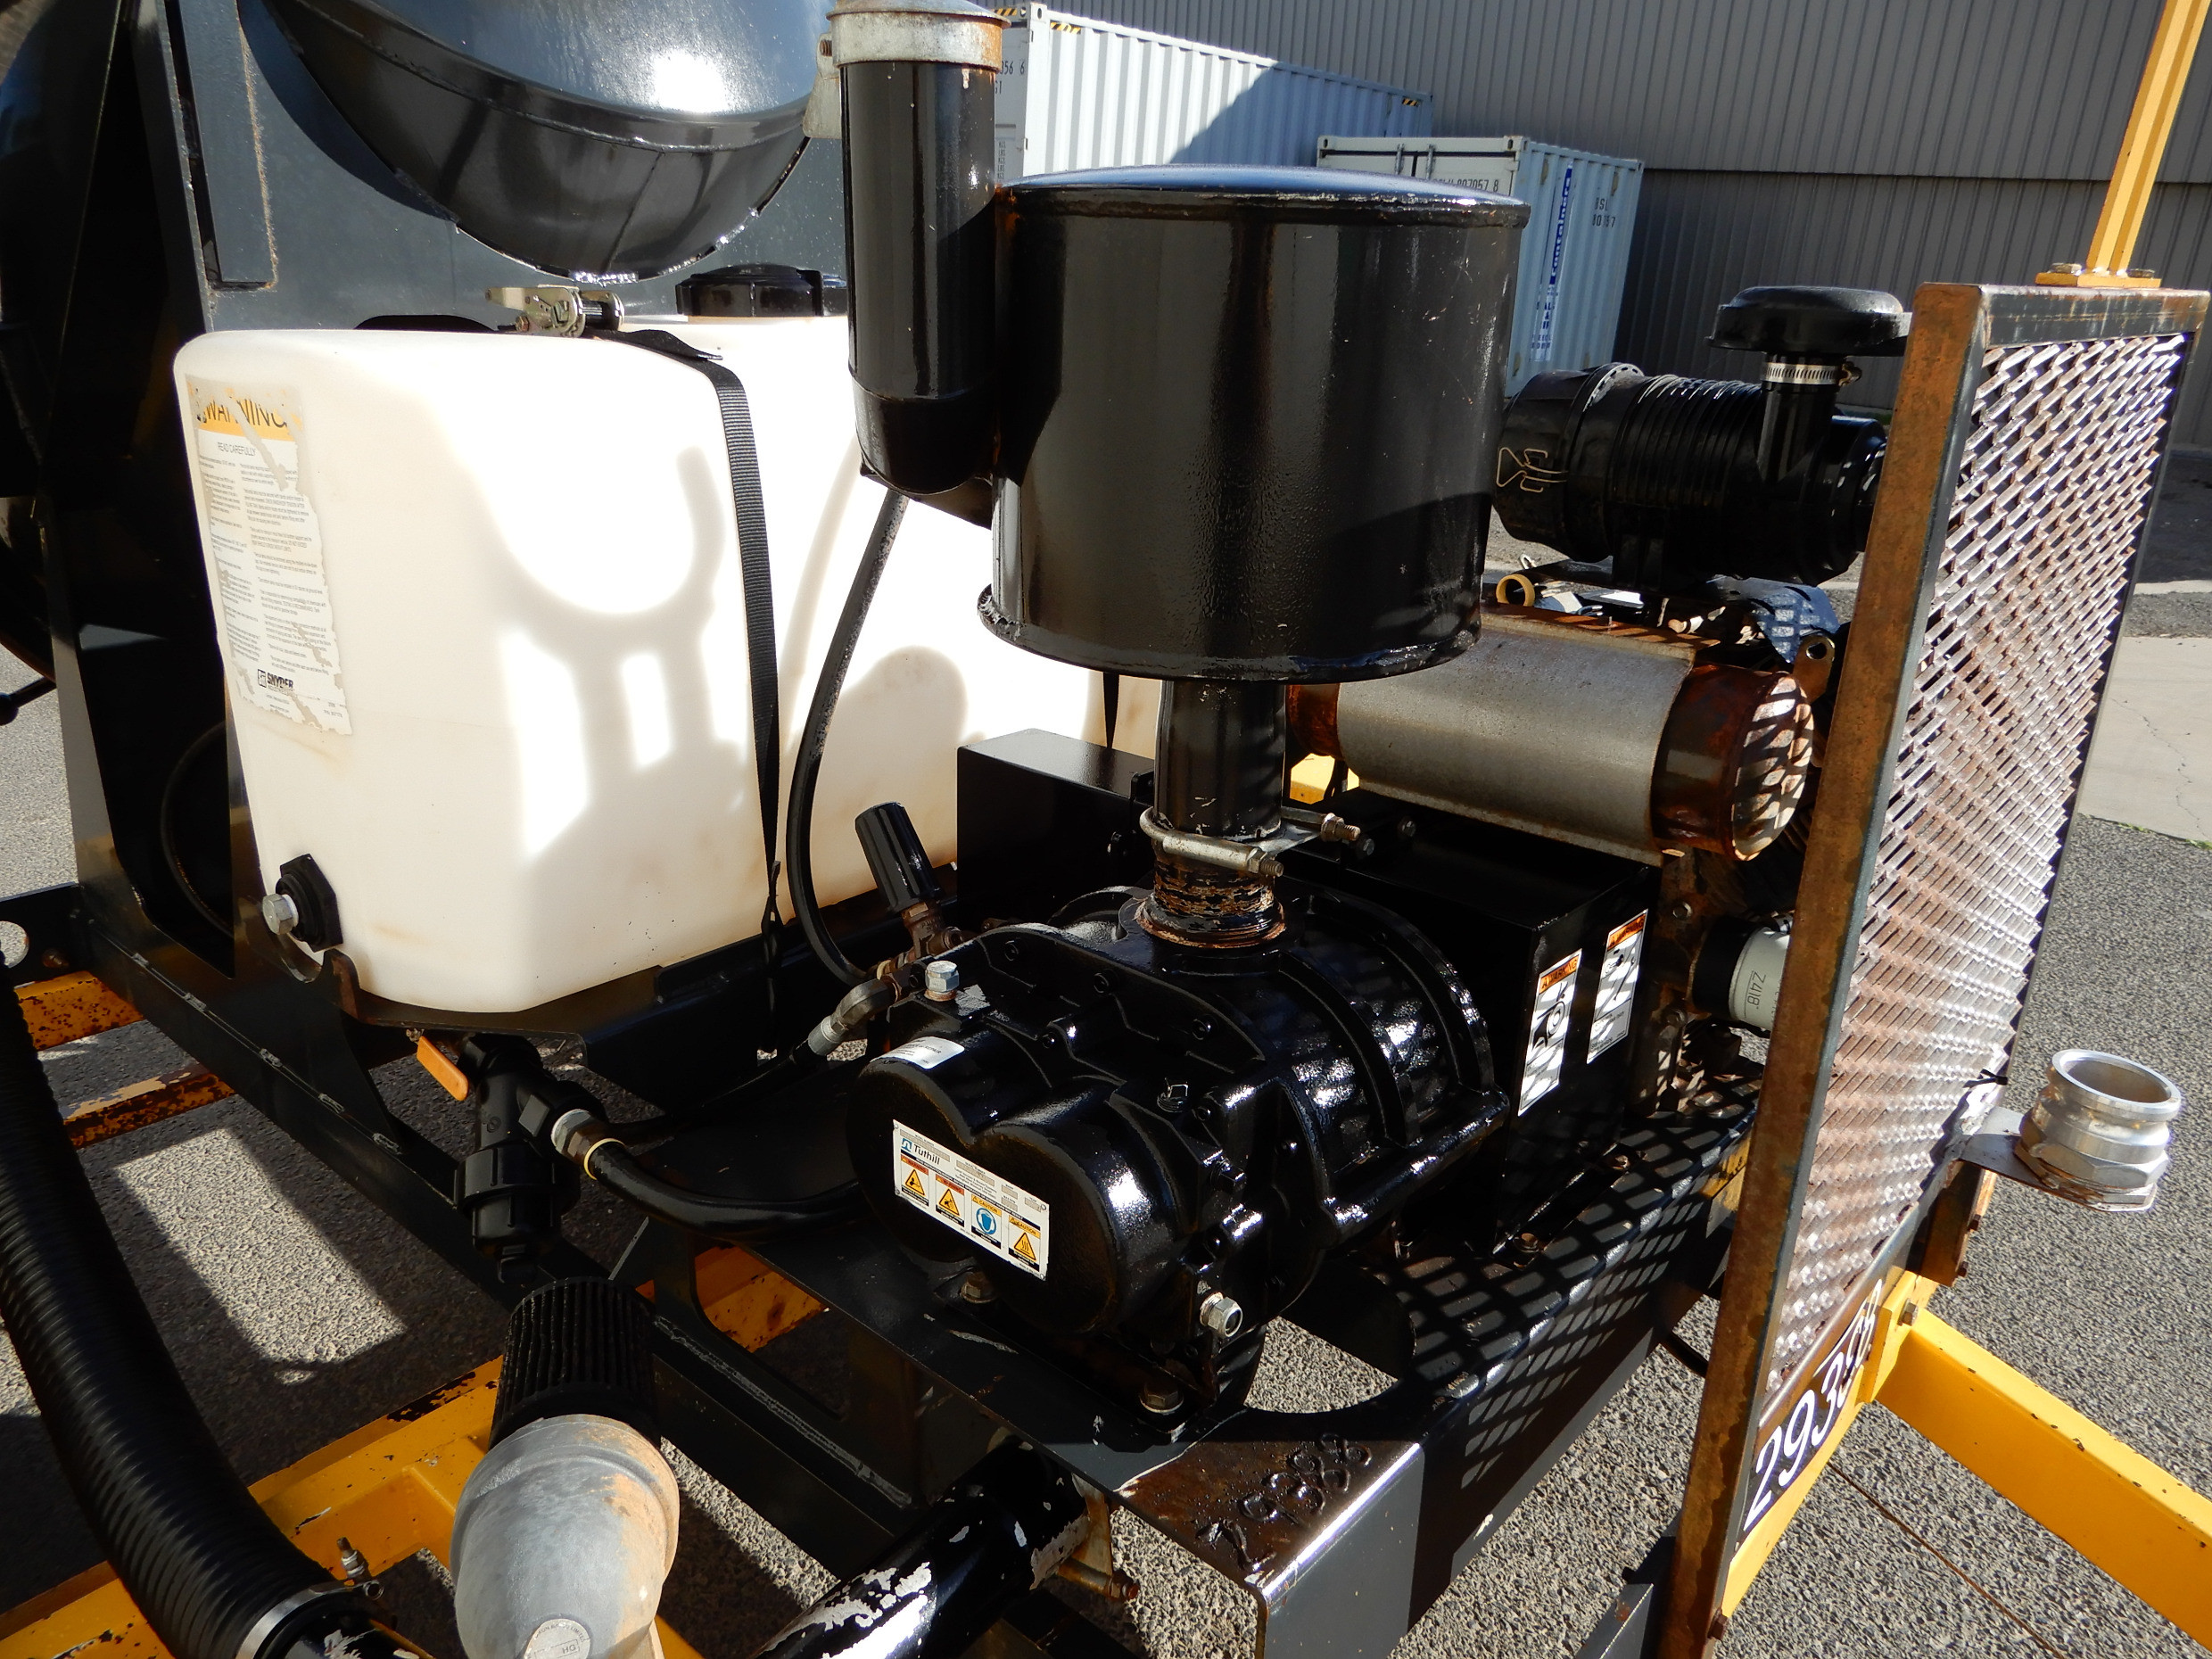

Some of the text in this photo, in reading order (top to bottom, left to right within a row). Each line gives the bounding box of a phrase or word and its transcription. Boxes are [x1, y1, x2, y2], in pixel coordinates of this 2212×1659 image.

[268, 672, 294, 689] SNYDER
[913, 1143, 940, 1166] Tuthill
[978, 1198, 998, 1213] CAUTION
[1017, 1220, 1036, 1235] CAUTION
